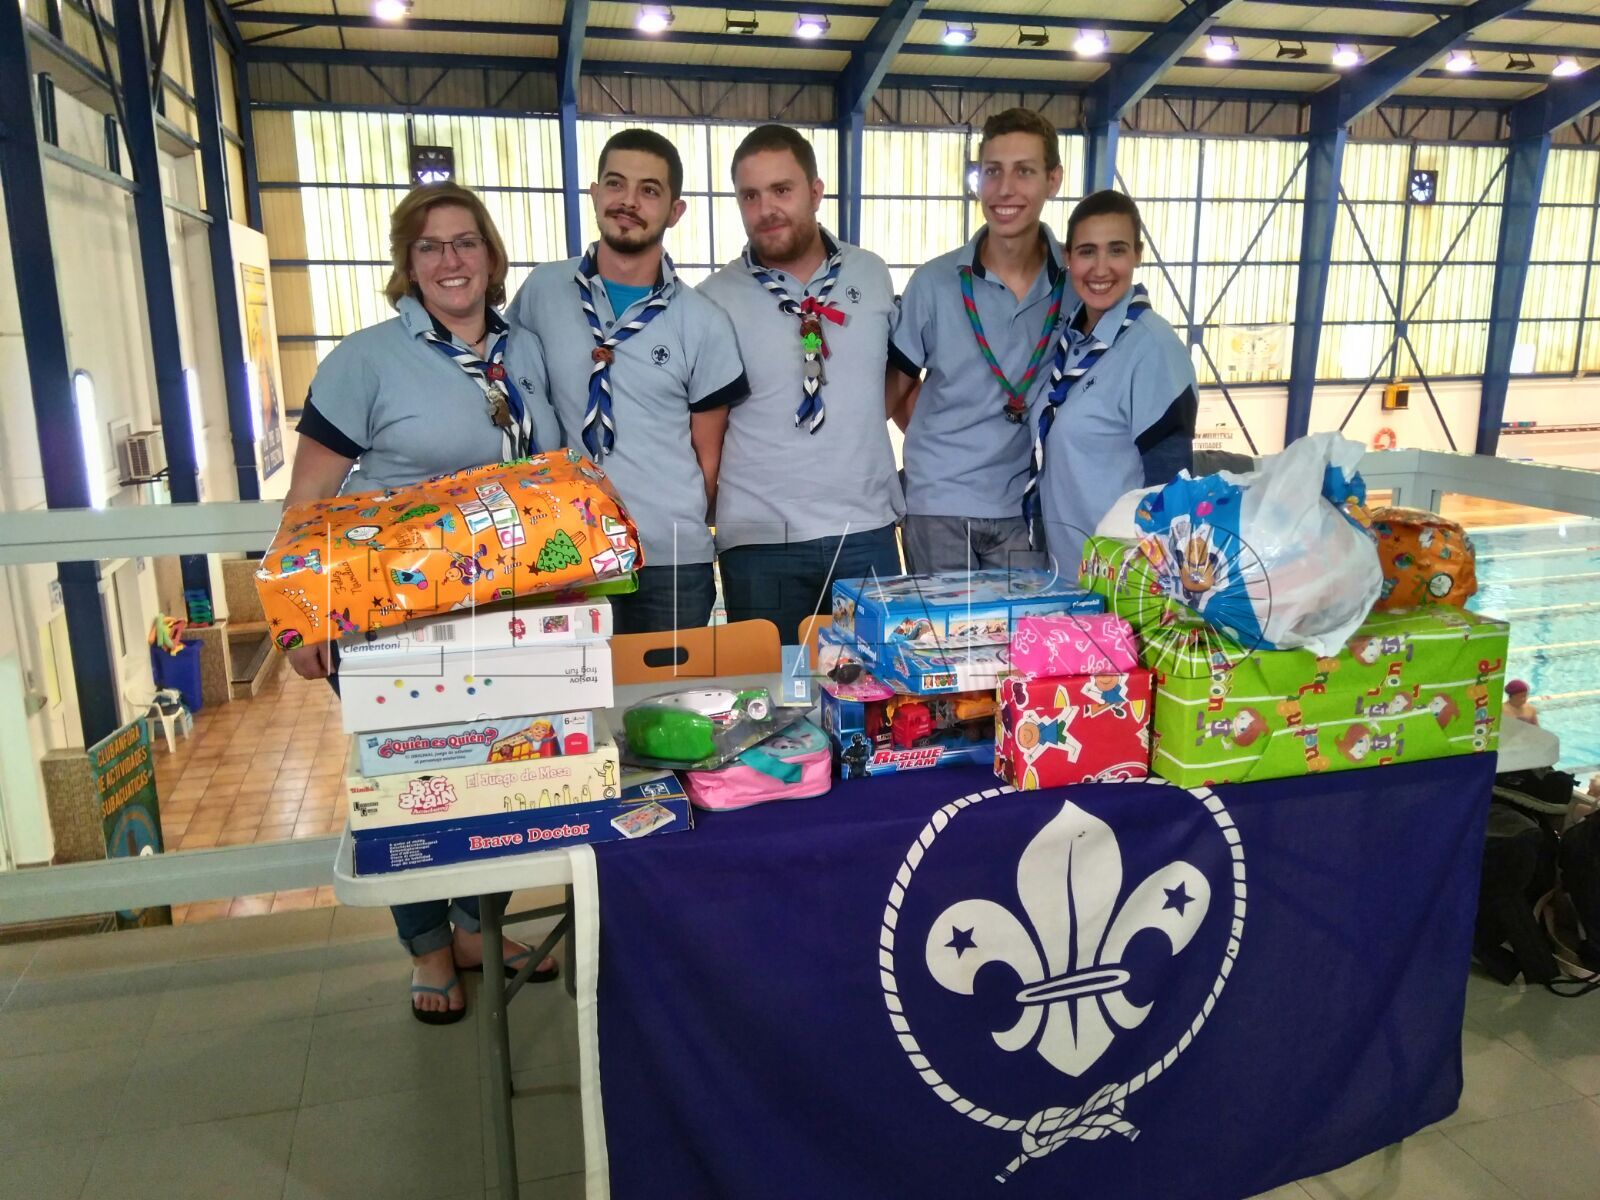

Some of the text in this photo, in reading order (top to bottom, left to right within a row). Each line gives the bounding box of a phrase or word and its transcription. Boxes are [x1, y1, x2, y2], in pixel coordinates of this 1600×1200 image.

[342, 642, 400, 654] Clementoni
[378, 735, 431, 758] ¿Quién
[431, 738, 447, 749] es
[448, 727, 498, 750] Quién?
[106, 745, 148, 787] ACTIVIDADES
[466, 766, 572, 788] El Juego de Mesa
[898, 758, 936, 769] TEAM
[102, 770, 148, 818] SUBACUATICAS
[470, 823, 590, 850] Brave Doctor
